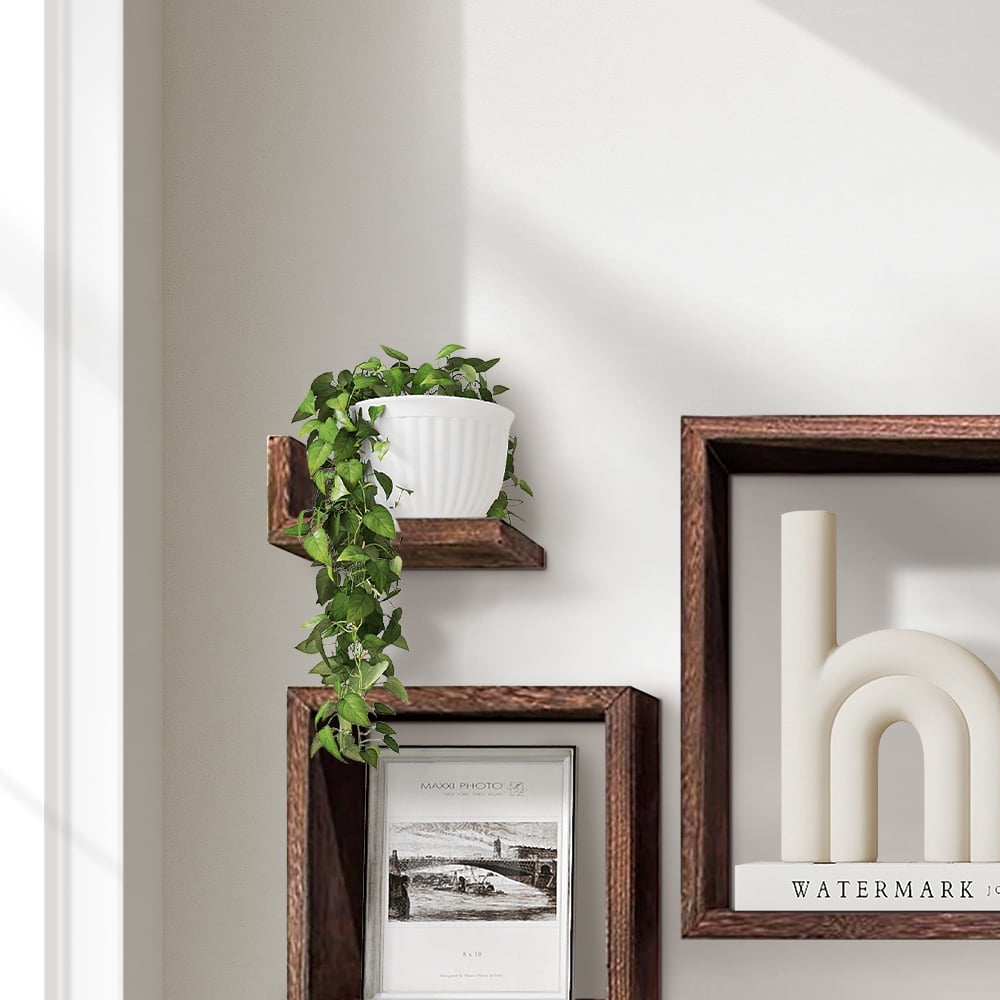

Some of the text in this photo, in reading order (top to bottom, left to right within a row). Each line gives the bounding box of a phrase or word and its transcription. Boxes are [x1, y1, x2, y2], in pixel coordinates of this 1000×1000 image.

[420, 782, 503, 790] MAXXI PHOTO
[791, 880, 975, 899] WATERMARK
